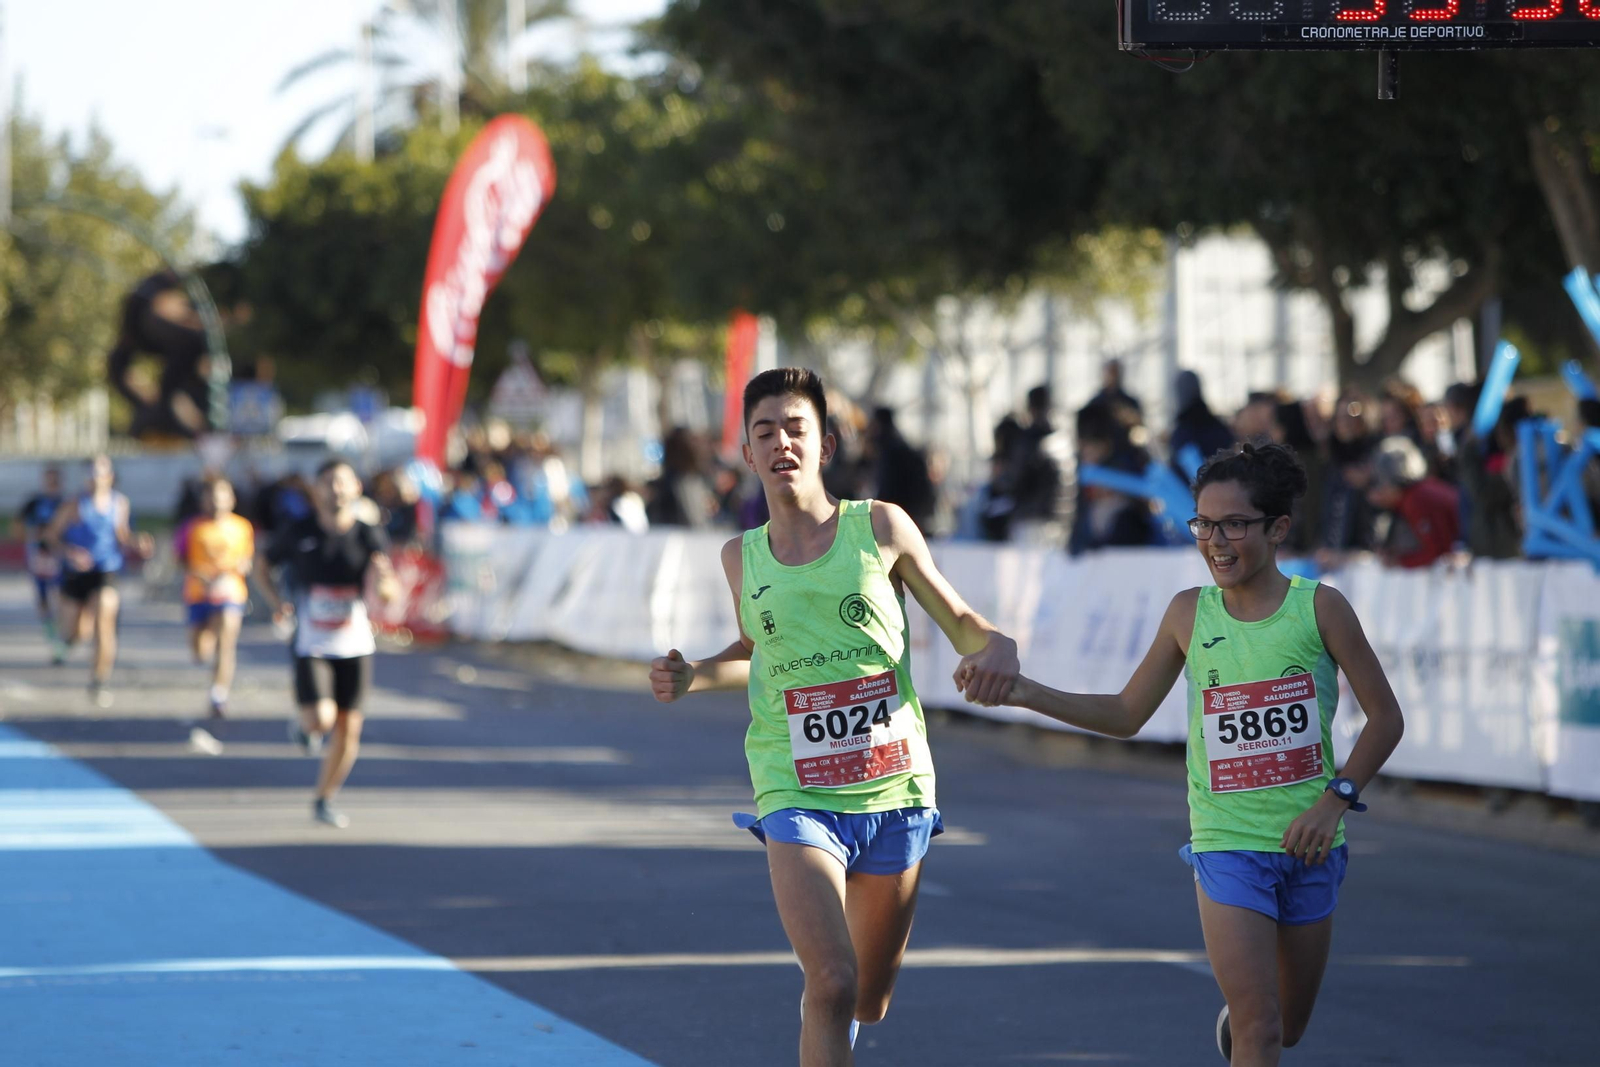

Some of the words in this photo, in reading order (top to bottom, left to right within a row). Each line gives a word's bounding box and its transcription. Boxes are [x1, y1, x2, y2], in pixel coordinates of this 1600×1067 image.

[1301, 26, 1407, 38] CRONOMETRAJE
[1410, 26, 1484, 38] DEPORTIVO
[857, 677, 890, 691] CARRERA
[1271, 680, 1308, 692] CARRERA
[849, 685, 892, 701] SALUDABLE
[1263, 688, 1309, 702] SALUDABLE
[803, 698, 892, 744] 6024
[1218, 703, 1309, 745] 5869
[1237, 736, 1292, 752] SEERGIO.11
